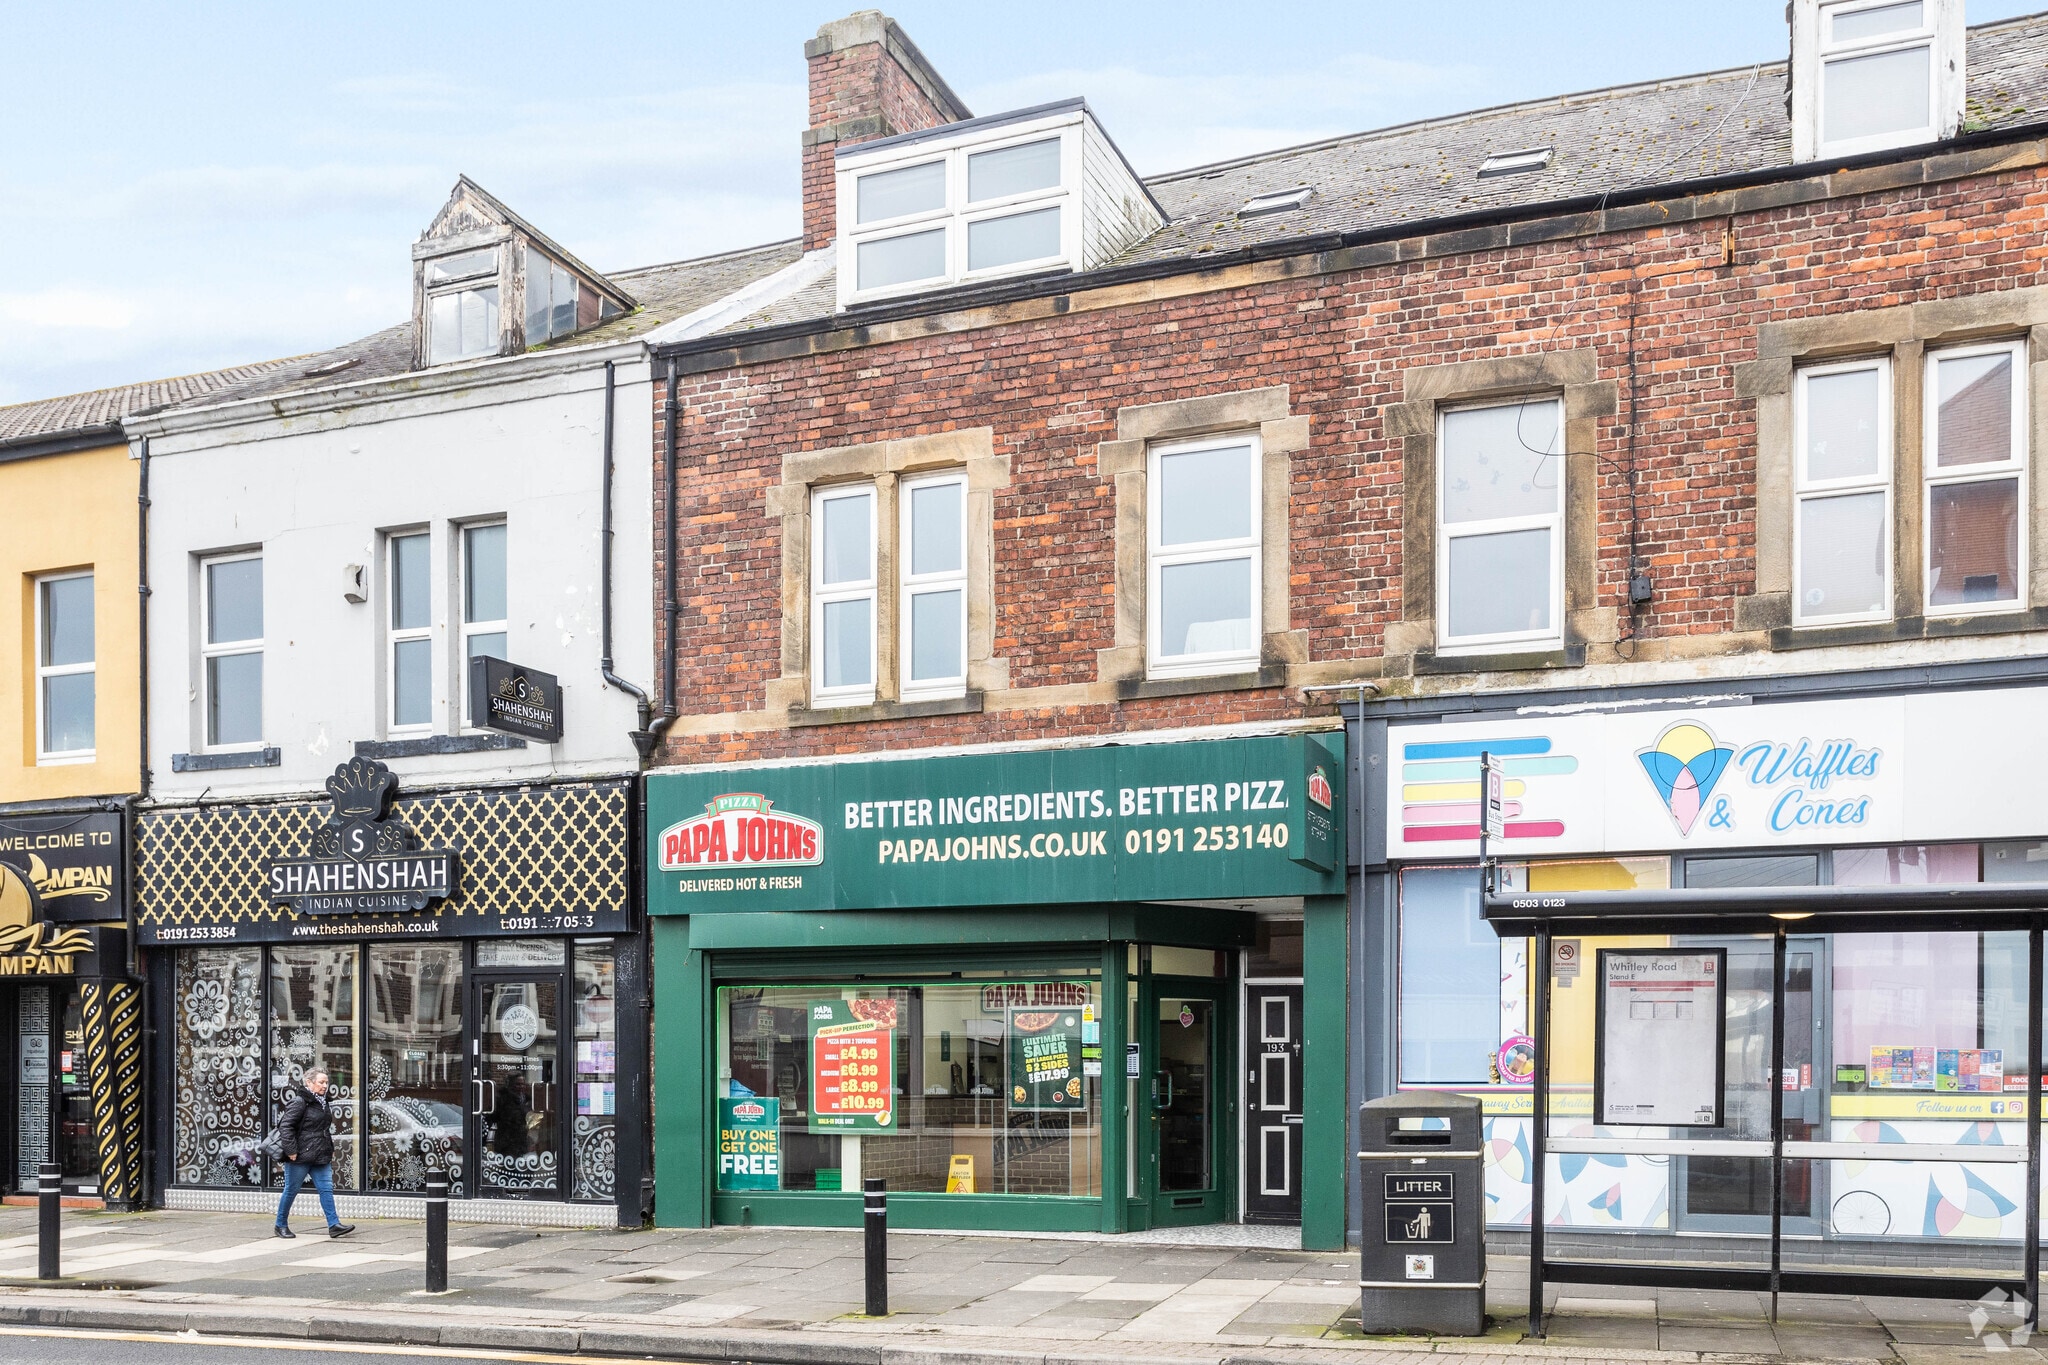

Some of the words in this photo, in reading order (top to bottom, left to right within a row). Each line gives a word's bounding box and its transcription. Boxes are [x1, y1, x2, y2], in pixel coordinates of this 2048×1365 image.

[518, 683, 526, 698] S
[493, 697, 553, 723] SHAHENSHAH
[503, 715, 522, 724] INDIAN
[523, 720, 543, 730] CUISINE
[1739, 741, 1879, 789] Waffles
[719, 796, 758, 809] PIZZA
[844, 798, 933, 829] BETTER
[939, 789, 1113, 825] INGREDIENTS.
[1119, 784, 1218, 816] BETTER
[1225, 780, 1289, 811] PIZZ
[1709, 798, 1731, 829] &
[1771, 789, 1869, 832] Cones
[0, 833, 84, 851] WELCOME
[90, 831, 112, 846] TO
[352, 829, 363, 852] S
[666, 820, 728, 865] PAPA
[732, 817, 816, 862] JOHN'S
[878, 831, 1107, 864] PAPAJOHNS.CO.UK
[1125, 827, 1184, 855] 0191
[1193, 823, 1288, 852] 253140
[271, 859, 447, 894] SHAHENSHAH
[679, 877, 734, 893] DELIVERED
[736, 877, 757, 891] HOT
[760, 877, 768, 890] &
[769, 876, 802, 890] FRESH
[309, 897, 353, 909] INDIAN
[358, 895, 408, 907] CUISINE
[1513, 899, 1539, 908] 0503
[1542, 898, 1566, 908] 0123
[190, 927, 209, 939] 253
[210, 926, 236, 938] 3854
[483, 953, 498, 961] TAKE
[527, 953, 561, 961] DELIVERY
[1610, 962, 1648, 973] Whitley
[1651, 962, 1677, 971] Road
[986, 983, 1028, 1008] PAPA
[813, 1006, 833, 1014] PAPA
[819, 1027, 842, 1036] PICK-UP
[842, 1022, 875, 1032] PERFECTION
[1026, 1033, 1066, 1046] ULTIMATE
[841, 1046, 878, 1060] £4.99
[1023, 1041, 1068, 1058] SAVER
[1266, 1042, 1285, 1053] 193
[841, 1062, 878, 1076] £6.99
[1033, 1063, 1040, 1072] 2
[1041, 1059, 1069, 1071] SIDES
[841, 1079, 878, 1093] £8.99
[841, 1095, 885, 1109] £10.99
[1916, 1100, 1954, 1113] Follow
[1956, 1104, 1968, 1112] us
[734, 1105, 746, 1114] PAPA
[721, 1129, 746, 1140] BUY
[749, 1129, 777, 1141] ONE
[721, 1141, 746, 1153] GET
[748, 1141, 777, 1153] ONE
[720, 1154, 778, 1175] FREE
[1395, 1181, 1442, 1192] LITTER
